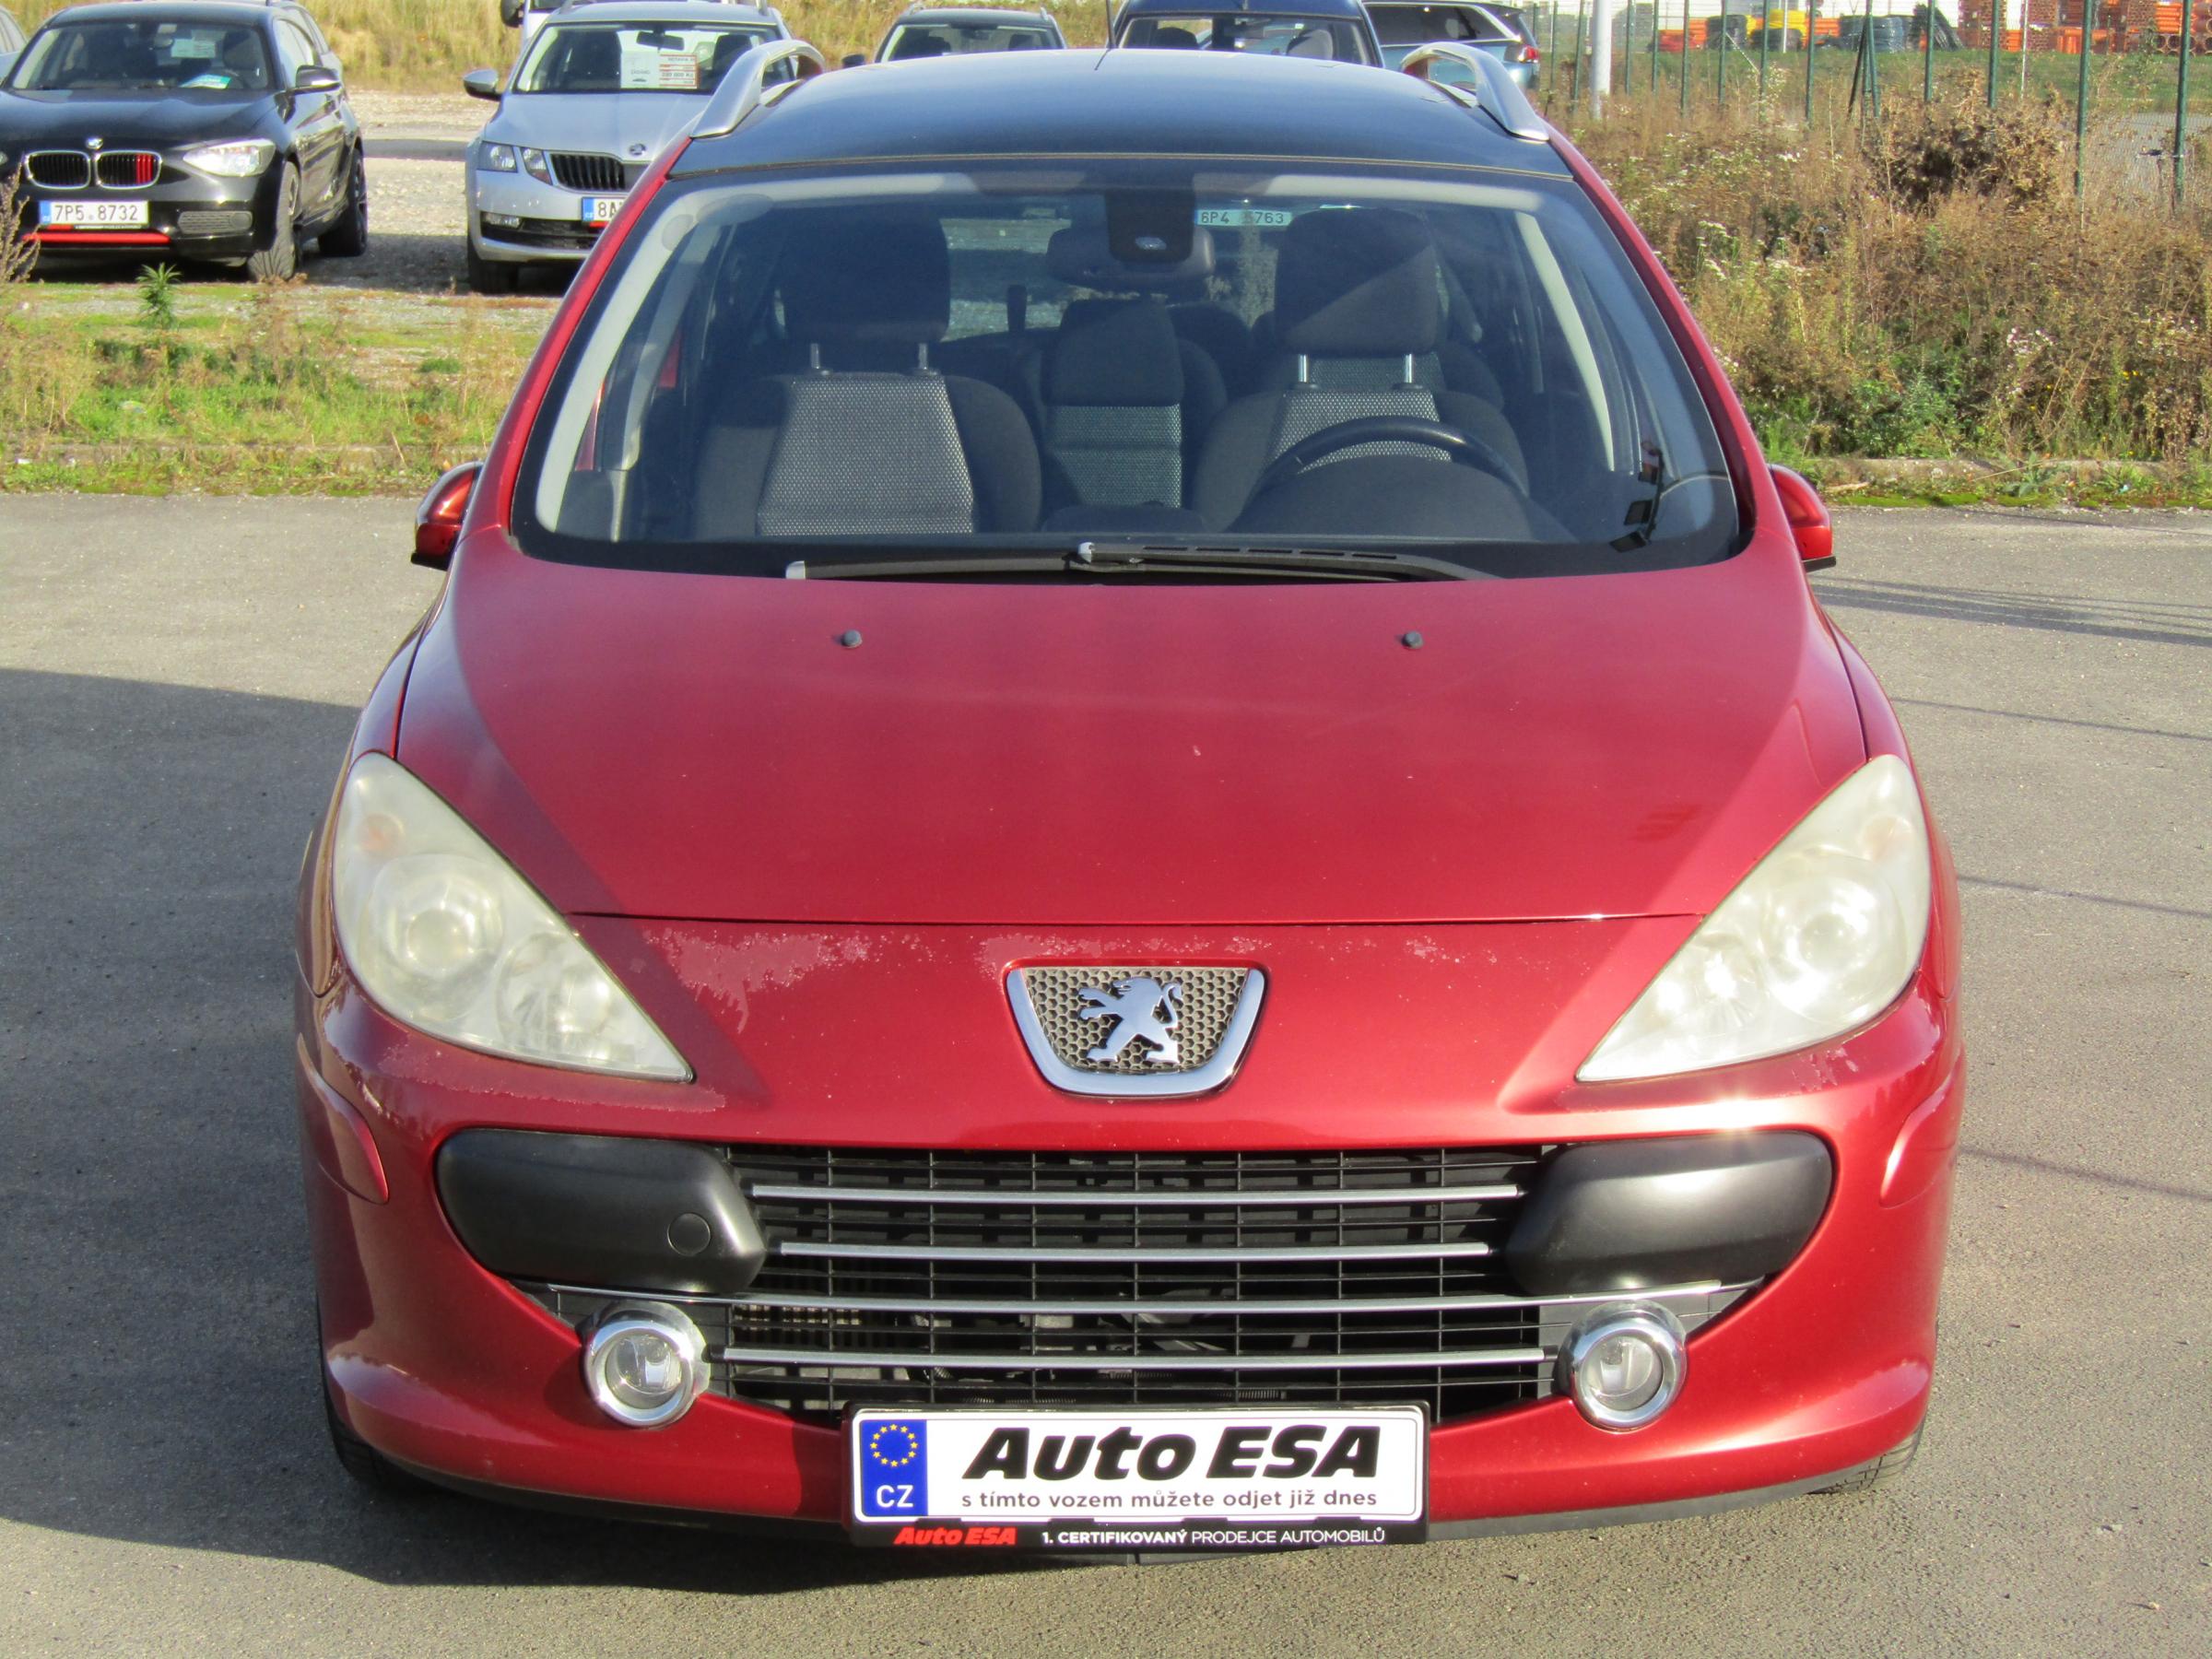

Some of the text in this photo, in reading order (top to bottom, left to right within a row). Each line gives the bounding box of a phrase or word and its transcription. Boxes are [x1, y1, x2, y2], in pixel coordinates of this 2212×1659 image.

[55, 205, 137, 221] 7P5 8732
[597, 201, 623, 218] 8A
[1201, 211, 1230, 223] 6P4
[961, 1424, 1381, 1481] Auto ESA
[876, 1484, 914, 1508] CZ
[961, 1488, 1377, 1509] s tímto vozem můžete odjet již dnes
[893, 1526, 1018, 1546] Auto ESA
[1041, 1526, 1386, 1545] 1. CERTIFIKOVANÝ PRODEJCE AUTOMOBILŮ
